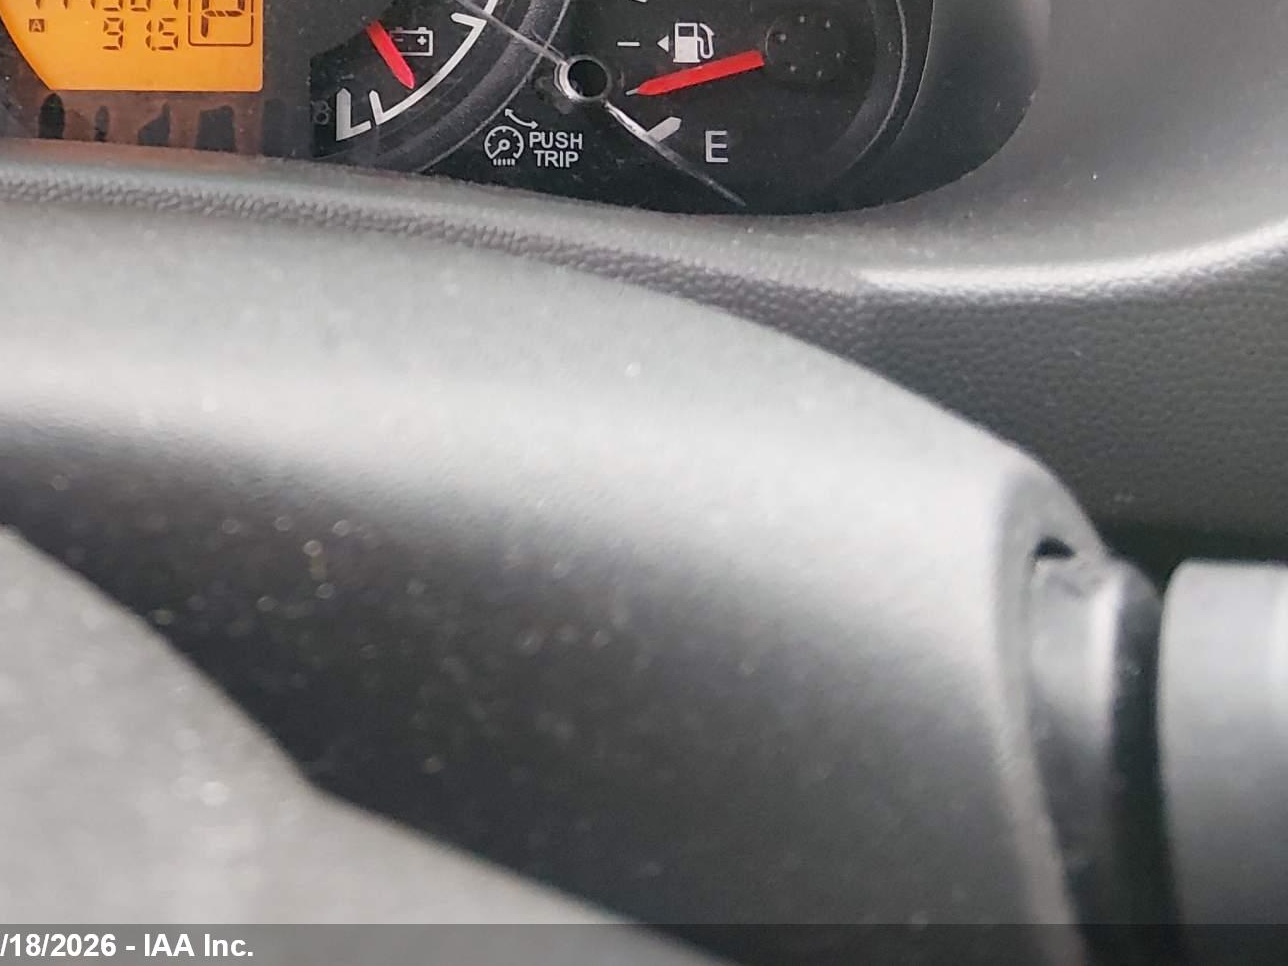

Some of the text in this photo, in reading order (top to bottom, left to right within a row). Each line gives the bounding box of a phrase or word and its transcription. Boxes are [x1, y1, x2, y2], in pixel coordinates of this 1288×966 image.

[528, 131, 583, 150] PUSH
[705, 130, 729, 163] E
[533, 149, 580, 168] TRIP
